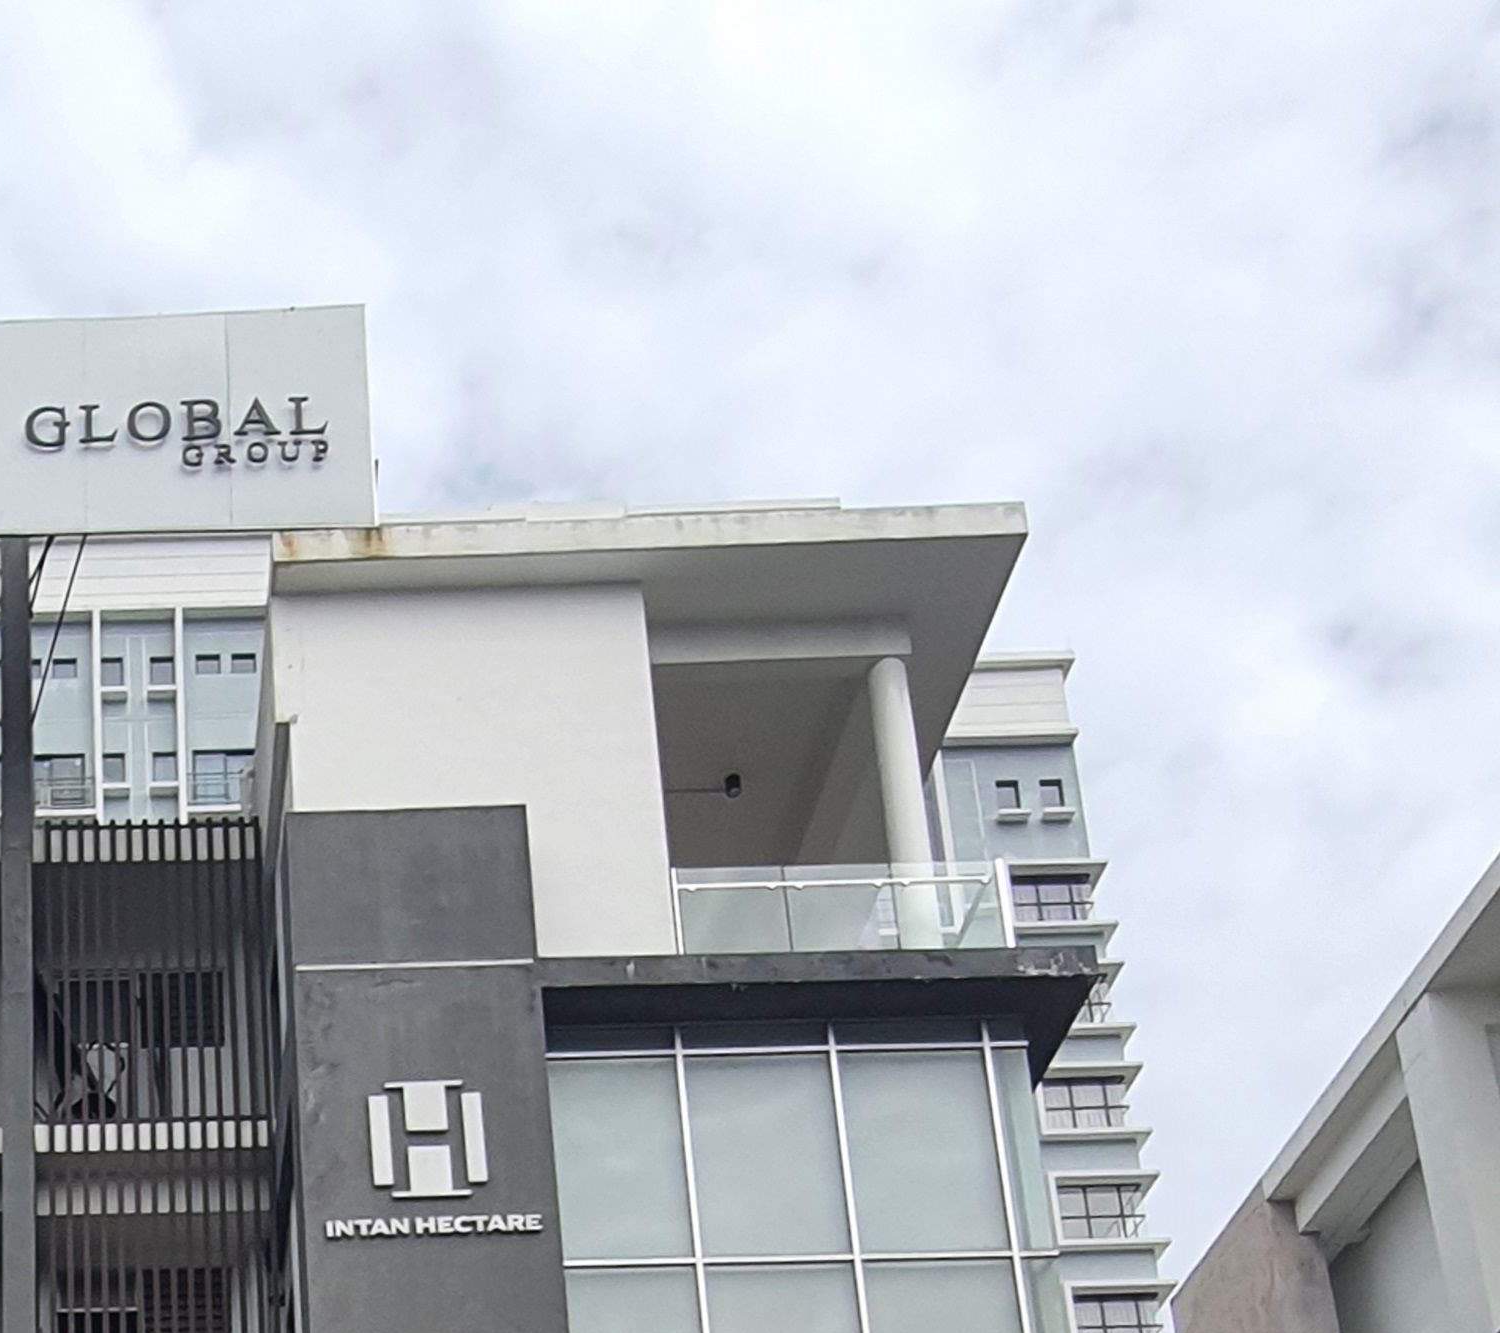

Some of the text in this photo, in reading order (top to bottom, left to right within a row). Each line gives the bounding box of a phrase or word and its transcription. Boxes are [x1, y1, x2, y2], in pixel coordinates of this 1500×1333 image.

[25, 396, 329, 447] GLOBAL
[182, 440, 329, 467] GROUP
[326, 1214, 543, 1238] INTAN HECTARE
